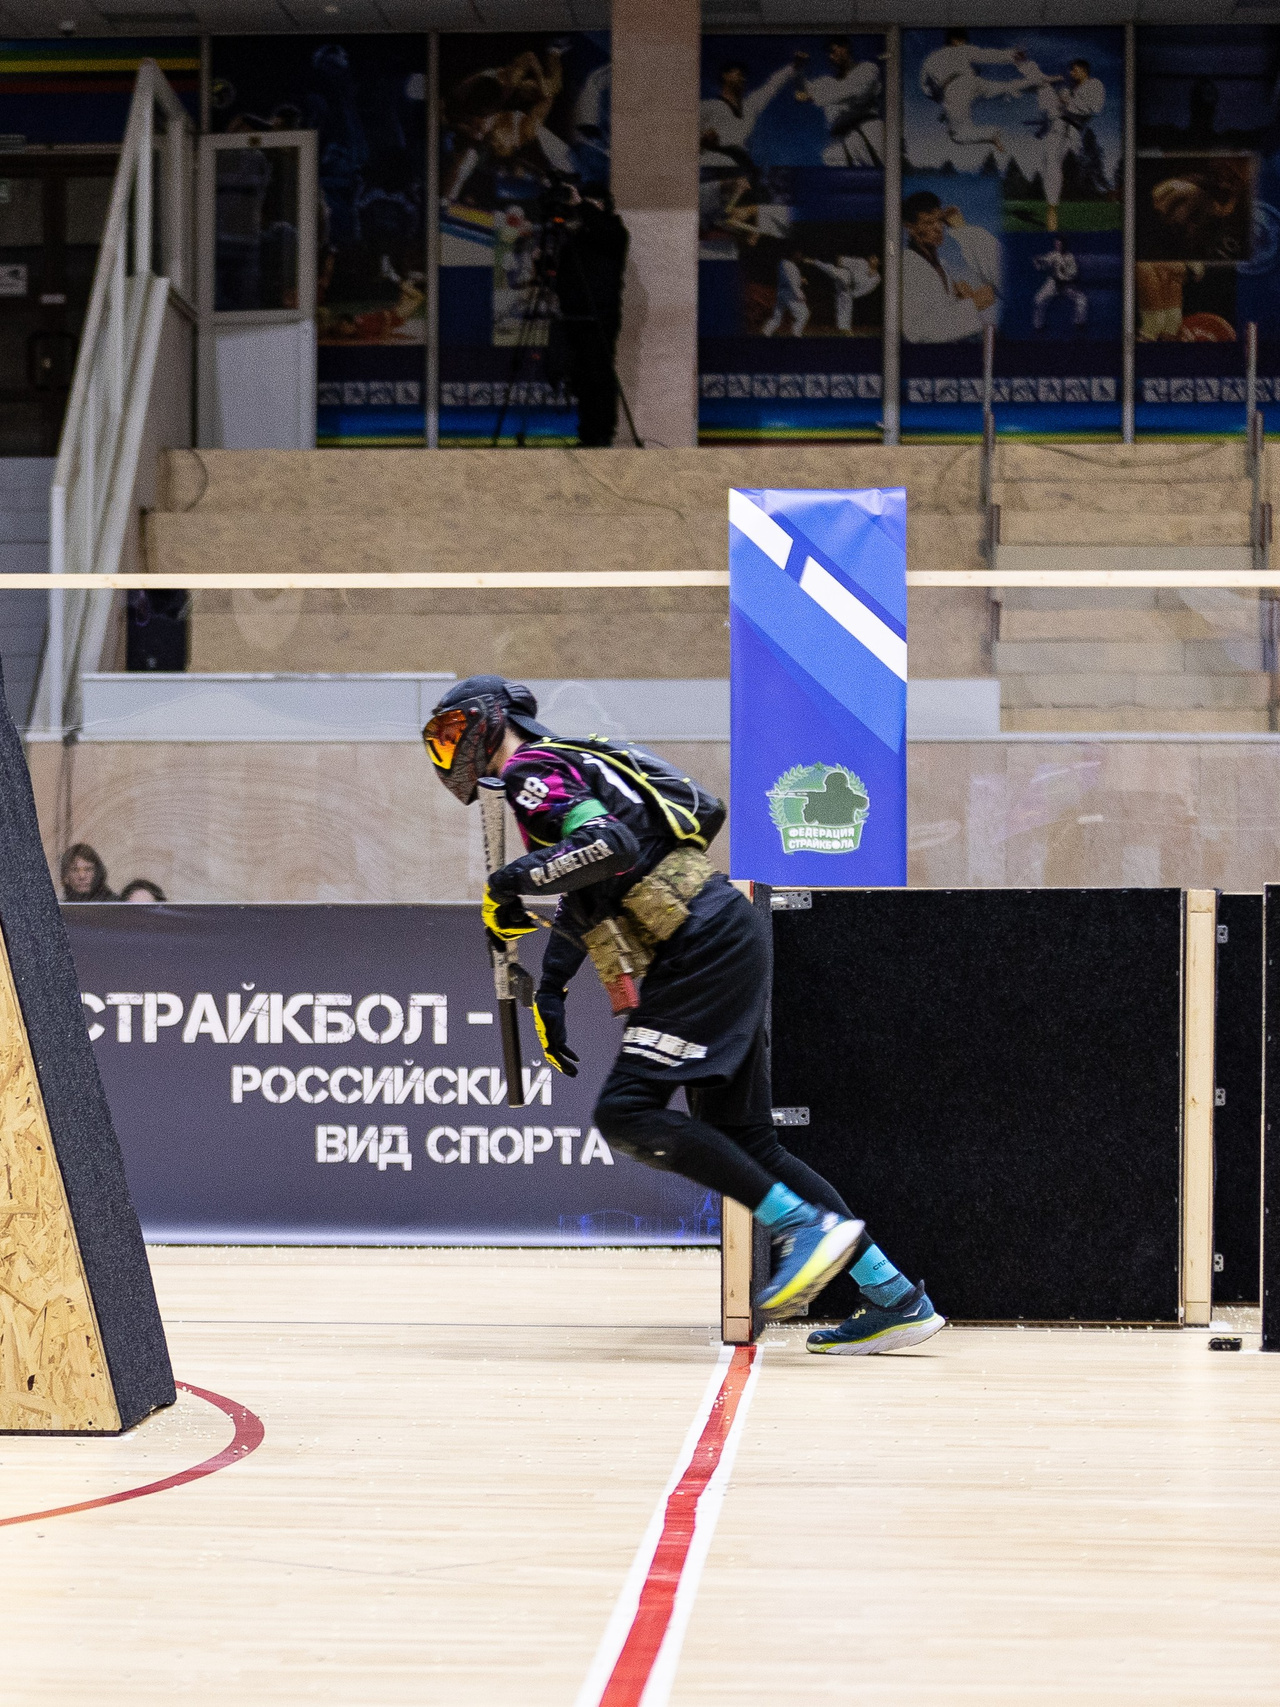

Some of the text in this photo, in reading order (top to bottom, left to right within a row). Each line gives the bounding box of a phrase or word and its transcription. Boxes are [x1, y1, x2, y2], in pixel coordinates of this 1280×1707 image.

[515, 776, 550, 810] 88
[787, 838, 855, 850] СТРАЙКБОЛА
[788, 826, 855, 839] ФЕДЕРАЦИЯ
[80, 981, 448, 1044] СТРАЙКБОЛ
[316, 1124, 615, 1171] ВИД СПОРТА
